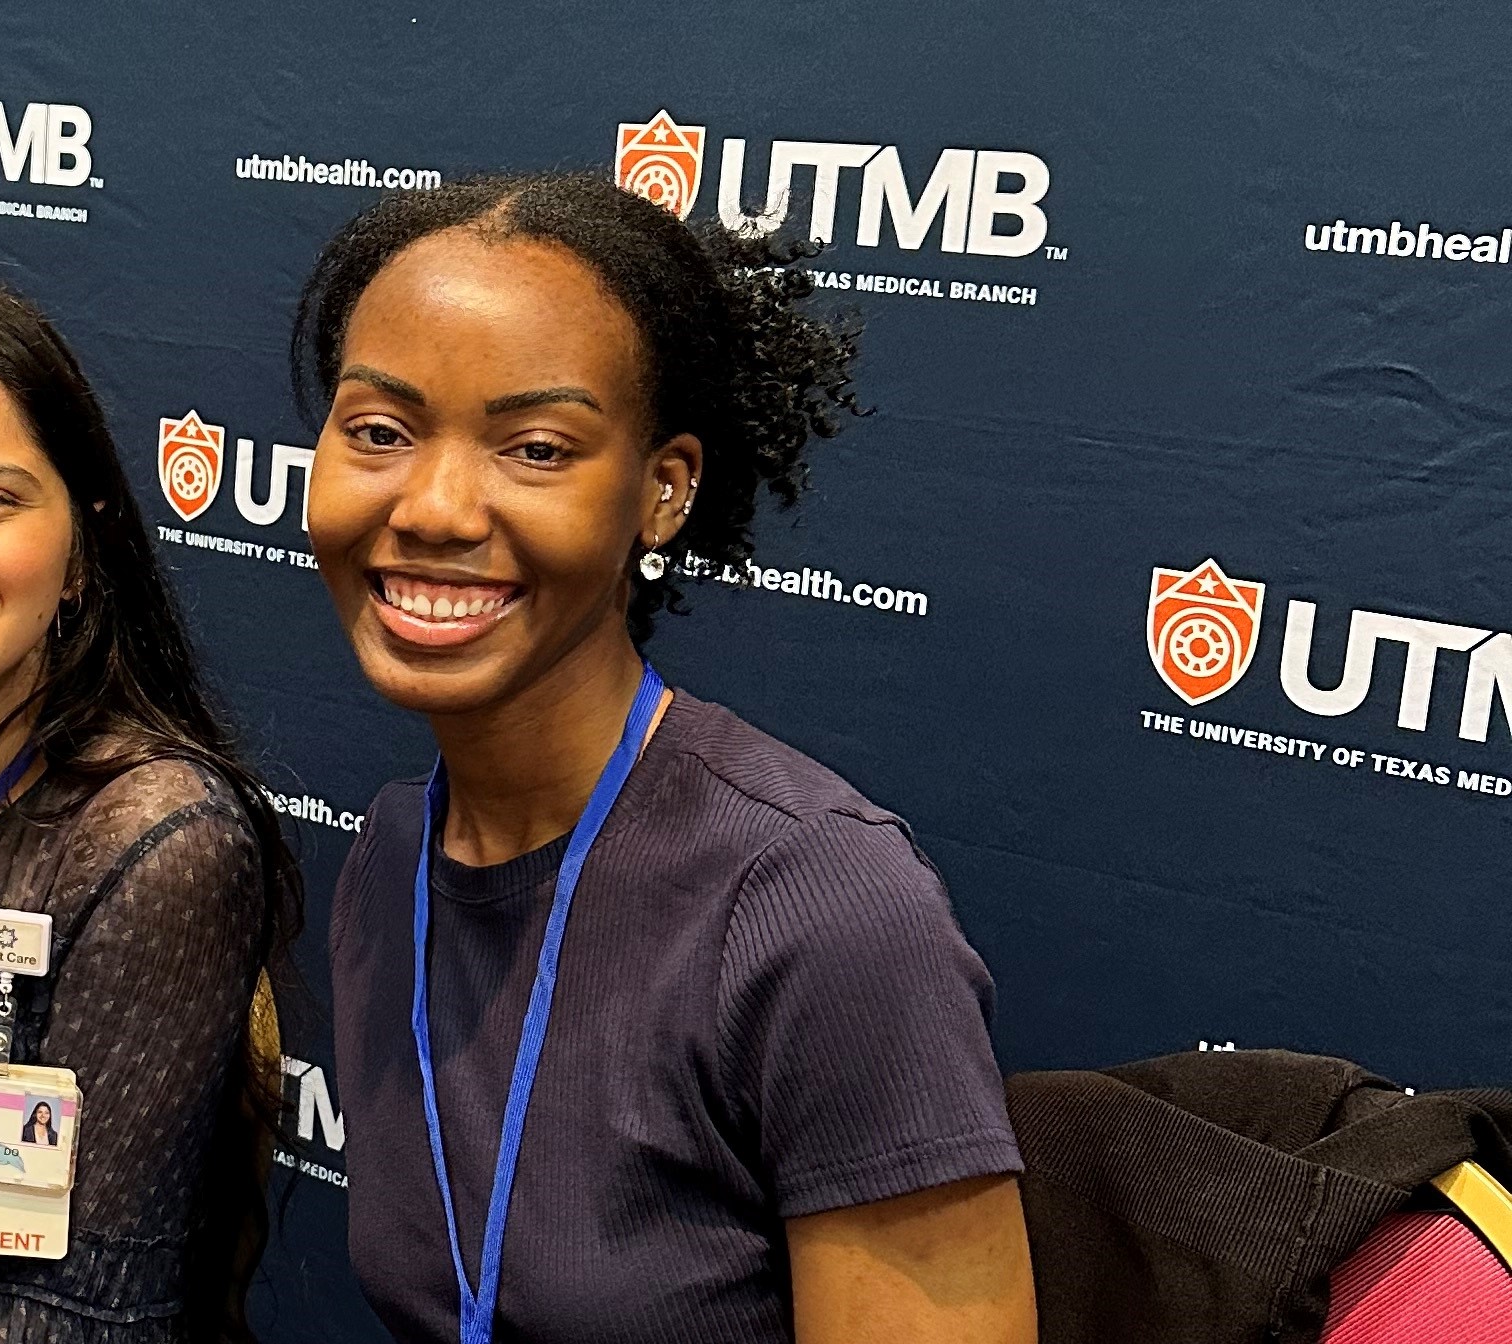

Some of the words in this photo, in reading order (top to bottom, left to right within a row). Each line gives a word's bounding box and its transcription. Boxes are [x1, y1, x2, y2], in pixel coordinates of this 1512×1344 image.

[236, 154, 441, 191] utmbhealth.com
[716, 137, 1051, 259] UTMB
[1304, 219, 1512, 264] utmbheal
[855, 274, 945, 298] MEDICAL
[949, 281, 1037, 306] BRANCH
[234, 438, 317, 533] UT
[157, 525, 184, 544] THE
[185, 531, 264, 559] UNIVERSITY
[266, 546, 286, 563] OF
[1140, 710, 1185, 735] THE
[1189, 719, 1327, 761] UNIVERSITY
[1332, 747, 1366, 768] OF
[1370, 753, 1451, 785] TEXAS
[1456, 770, 1512, 796] MED
[6, 950, 37, 966] Care
